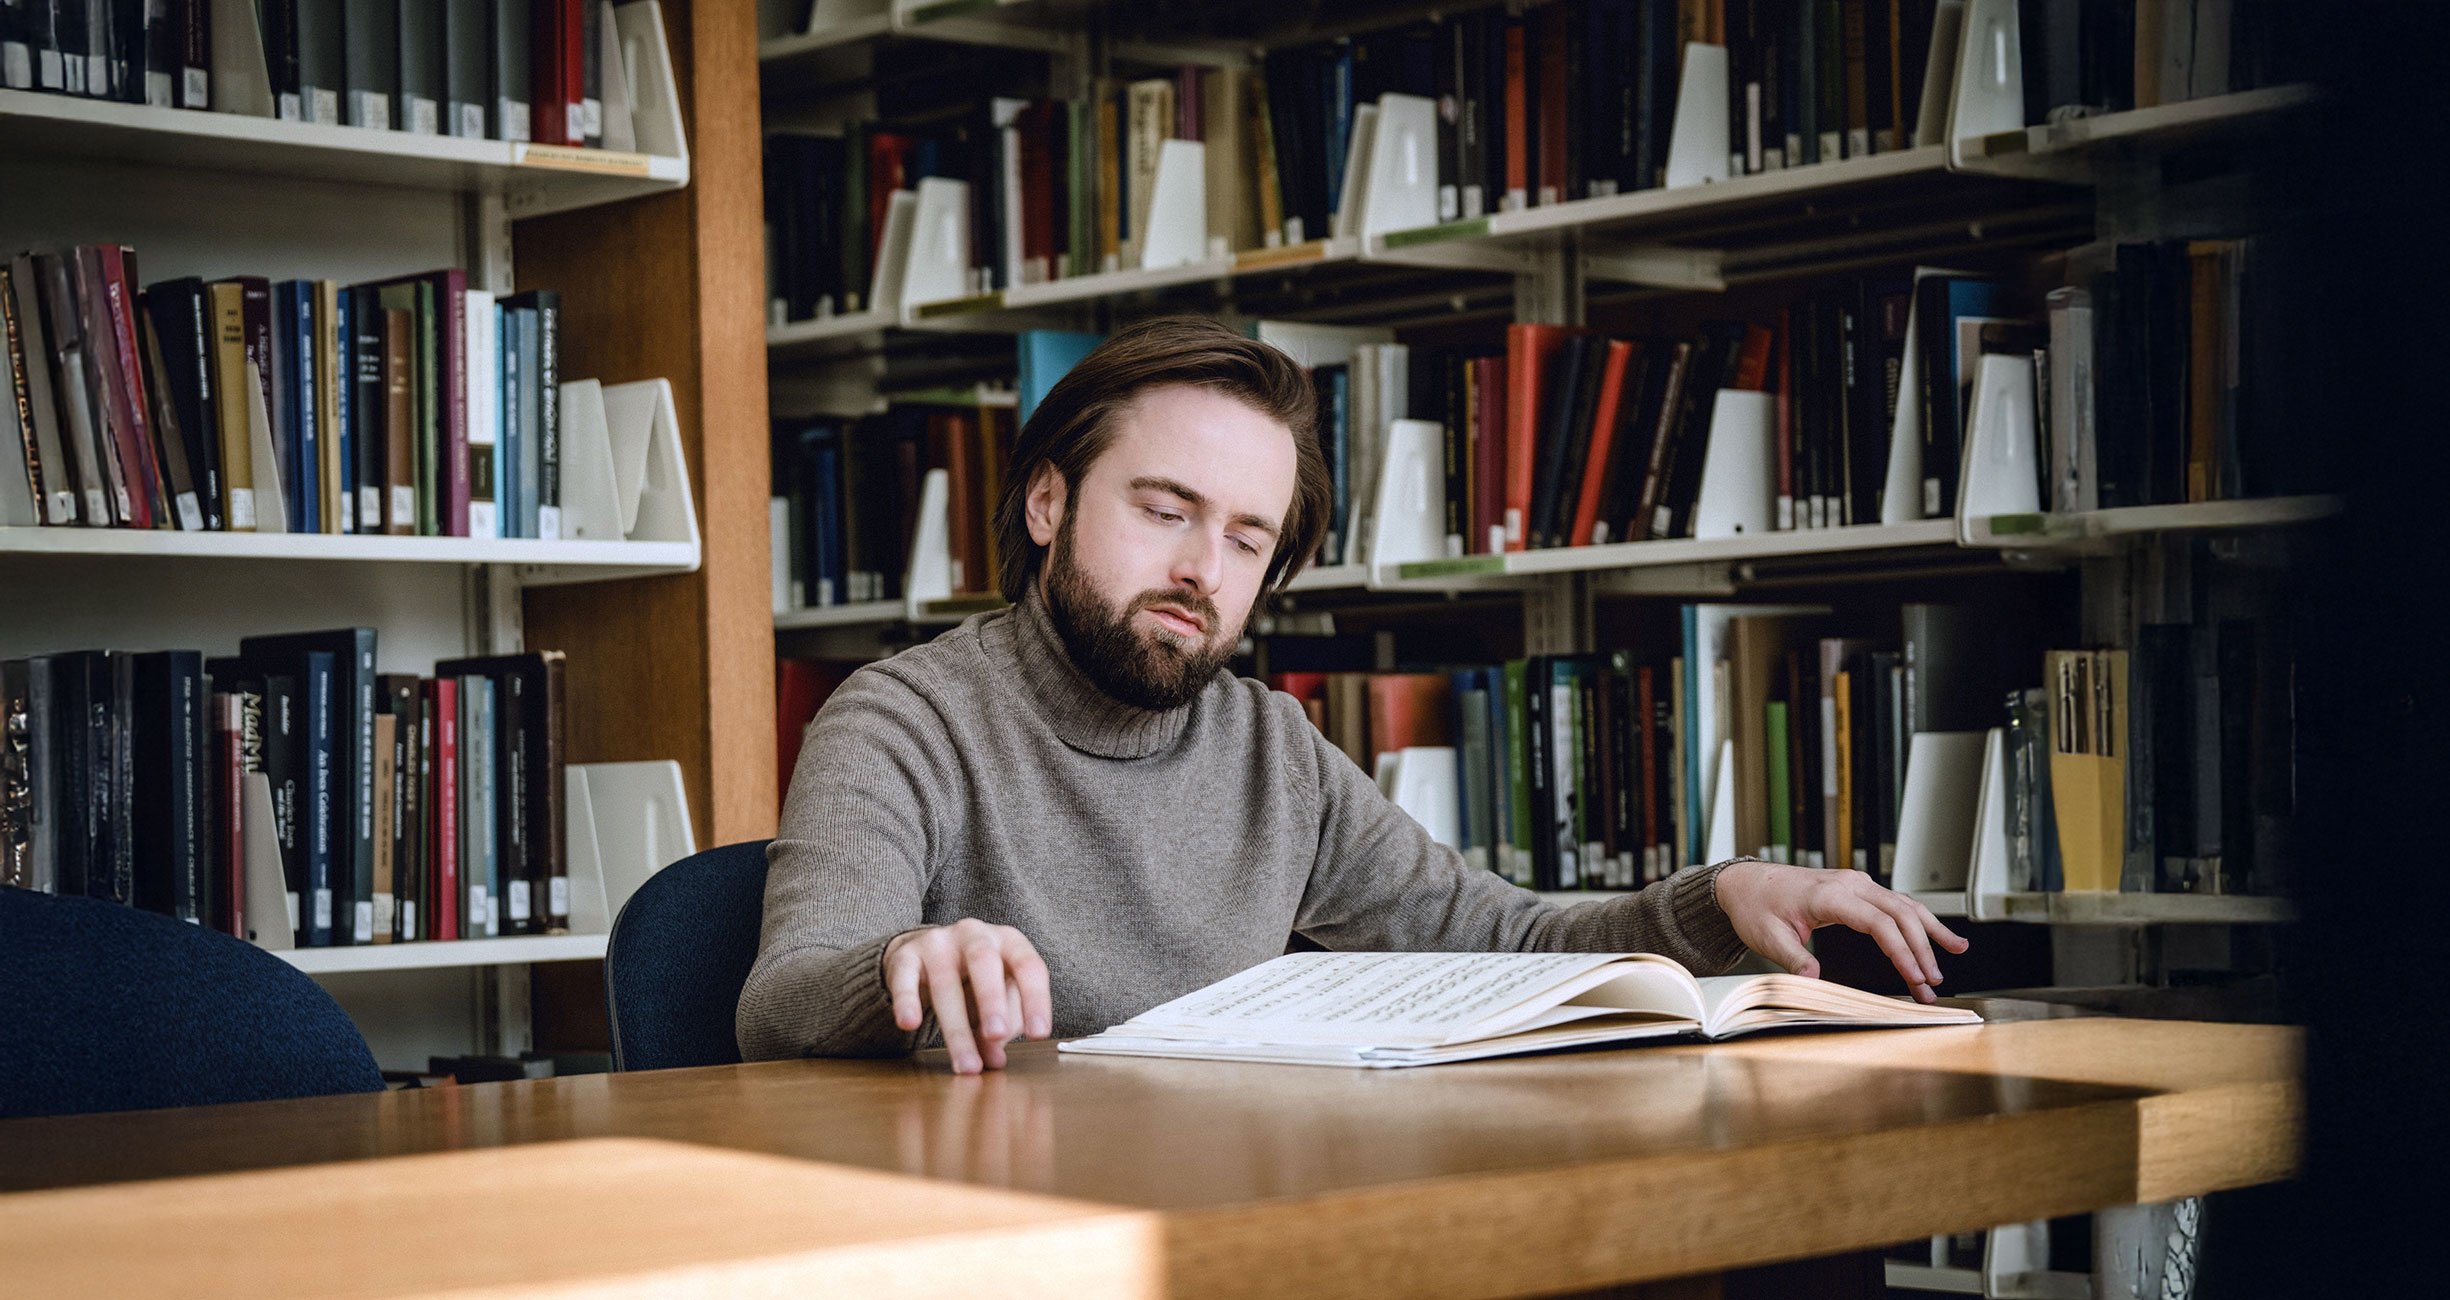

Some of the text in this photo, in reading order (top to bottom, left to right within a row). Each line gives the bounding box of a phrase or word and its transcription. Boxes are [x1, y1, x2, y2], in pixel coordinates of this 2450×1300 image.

[319, 750, 329, 767] An
[407, 725, 416, 774] CHARLES
[285, 780, 296, 822] Charles
[319, 769, 328, 791] Ives
[319, 792, 330, 853] Celebration
